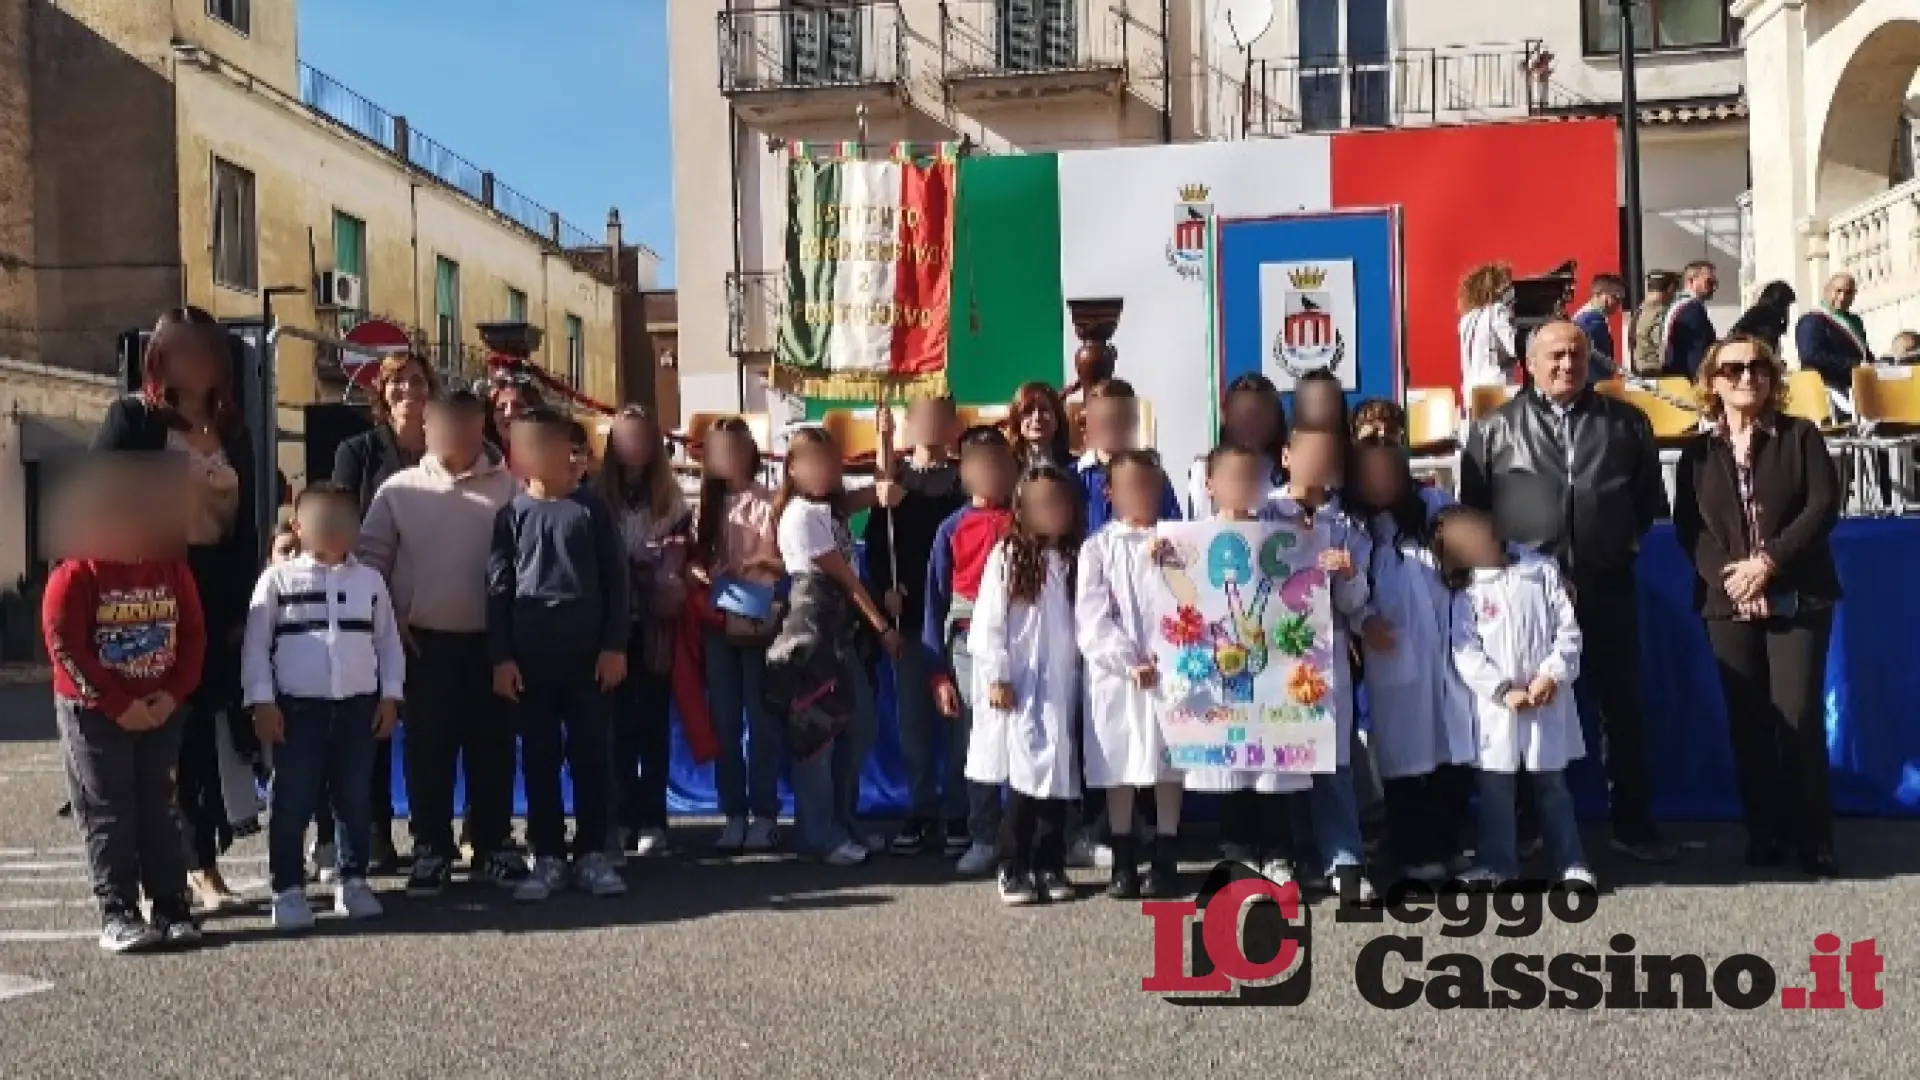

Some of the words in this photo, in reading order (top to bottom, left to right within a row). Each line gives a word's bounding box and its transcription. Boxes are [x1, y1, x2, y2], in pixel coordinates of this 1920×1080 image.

[814, 203, 920, 229] ISTITUTO
[801, 240, 940, 264] COMPRENSIVO
[858, 271, 870, 292] 2
